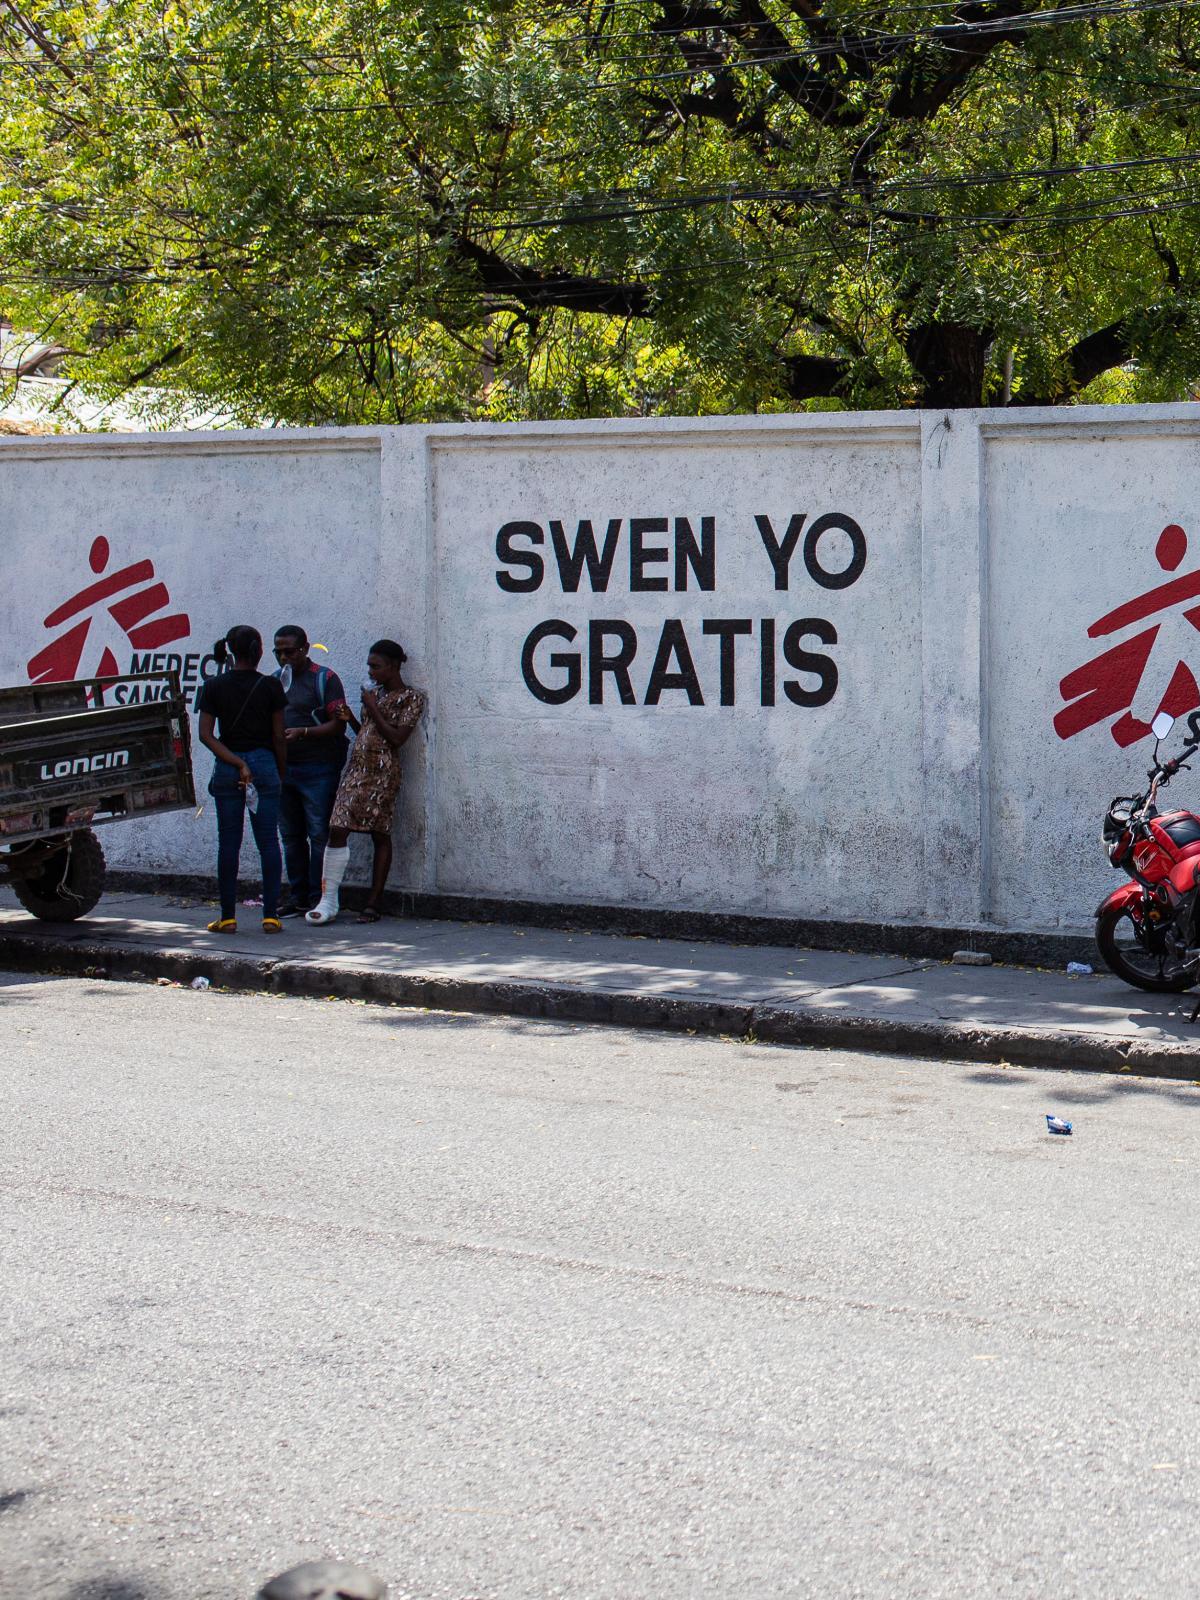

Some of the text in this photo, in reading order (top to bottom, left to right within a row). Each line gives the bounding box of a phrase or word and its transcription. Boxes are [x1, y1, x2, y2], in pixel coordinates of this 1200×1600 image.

[495, 512, 867, 593] SWEN YO
[521, 617, 839, 708] GRATIS
